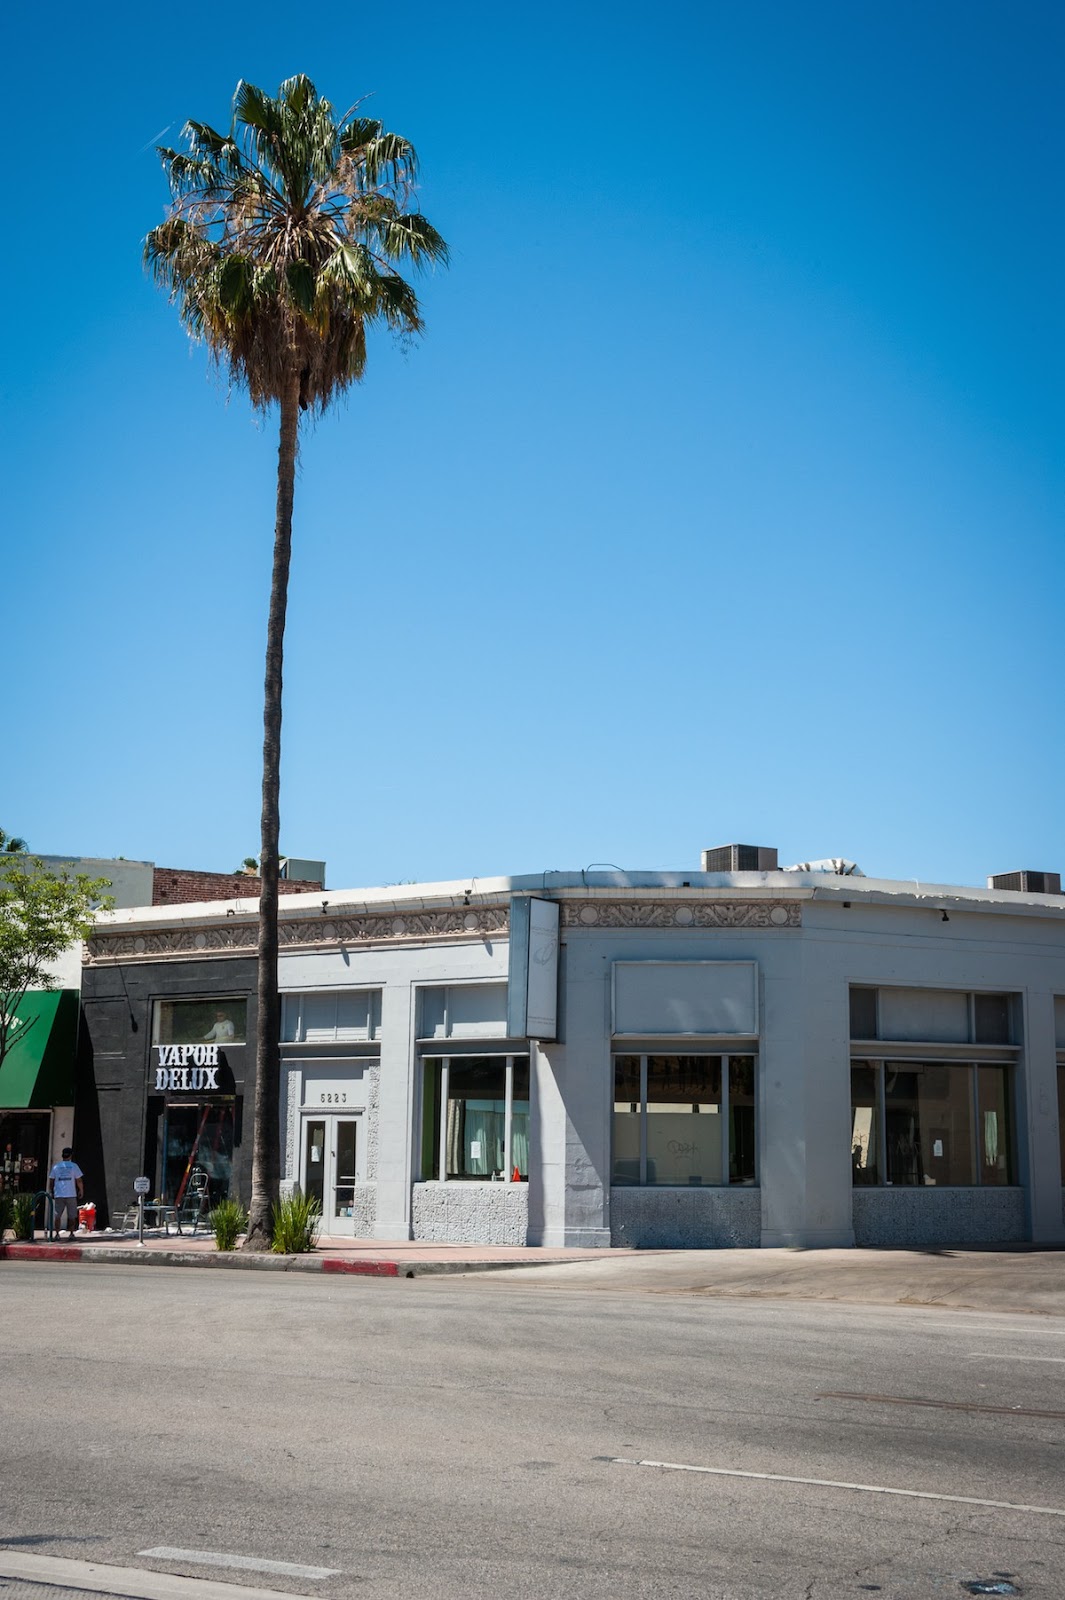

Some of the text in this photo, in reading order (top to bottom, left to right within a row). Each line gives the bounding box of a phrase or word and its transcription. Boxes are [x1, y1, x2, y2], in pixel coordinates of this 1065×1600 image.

[158, 1044, 219, 1066] VAPOR
[155, 1067, 220, 1090] DELUX
[318, 1093, 347, 1103] 5223
